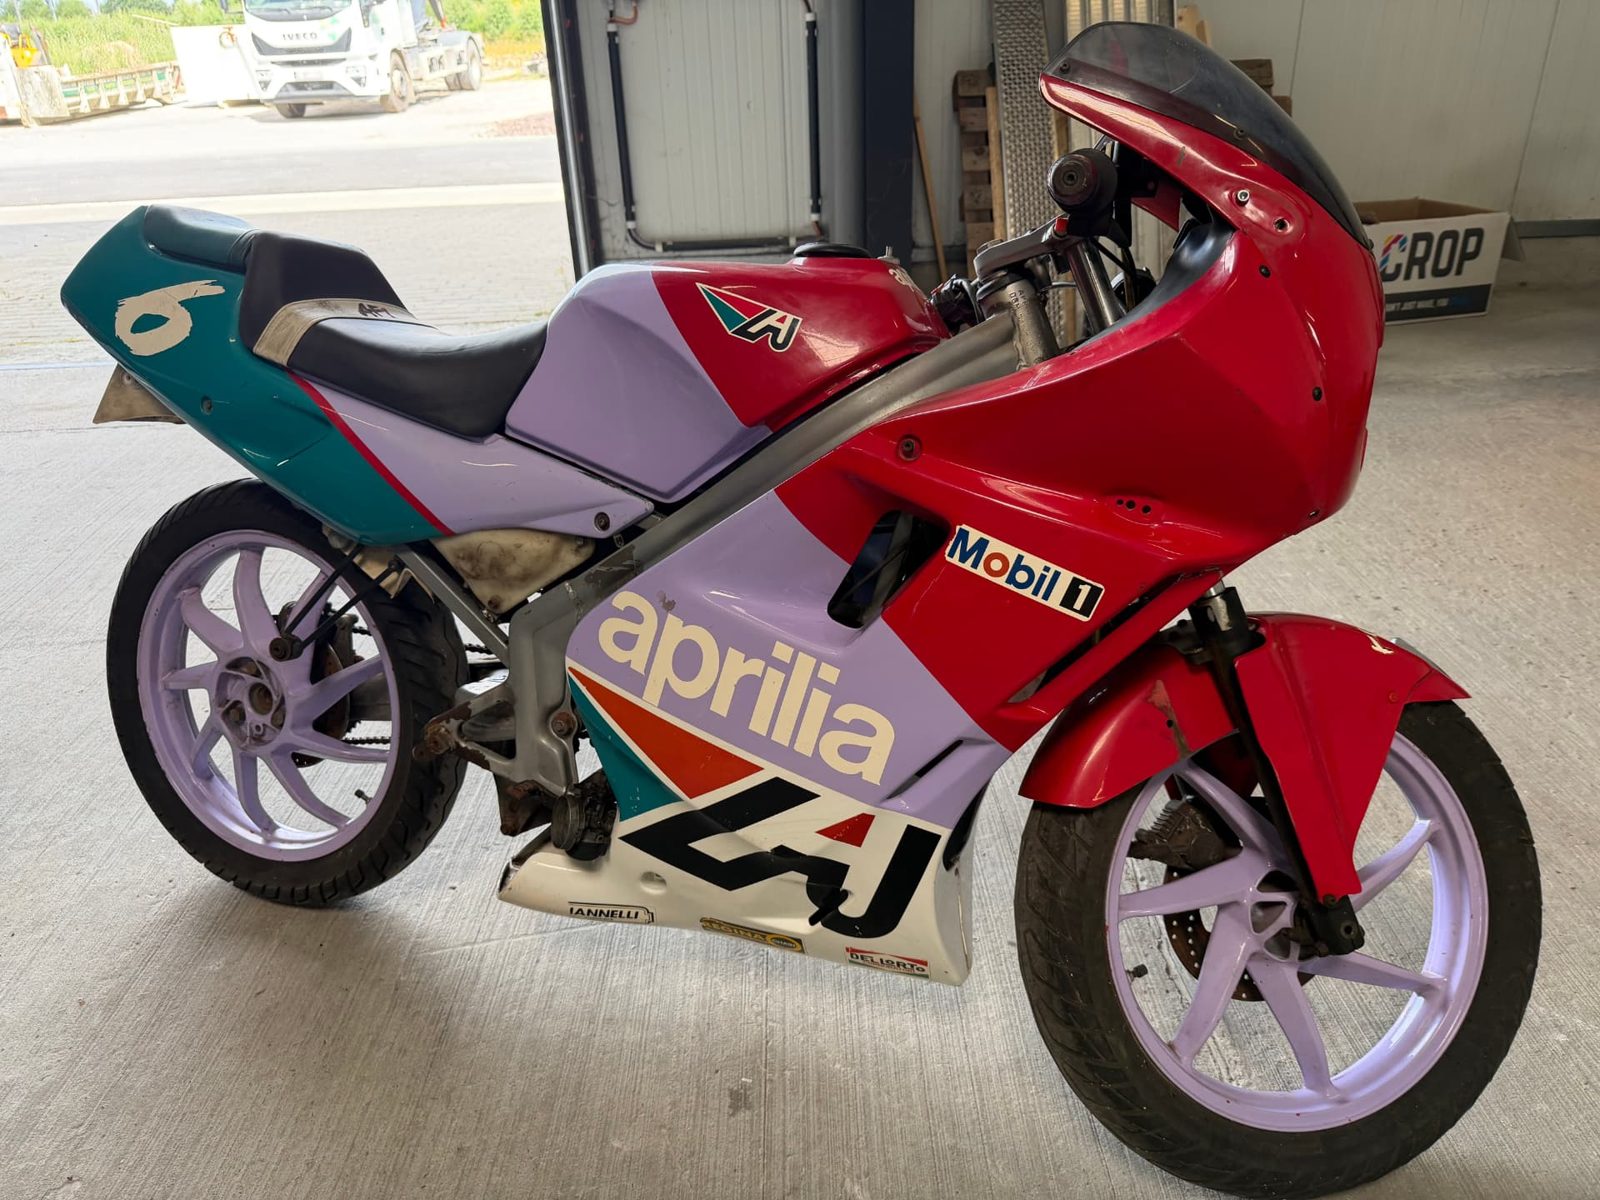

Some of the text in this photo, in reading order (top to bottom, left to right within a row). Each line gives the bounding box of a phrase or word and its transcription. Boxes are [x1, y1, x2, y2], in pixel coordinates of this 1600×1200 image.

[282, 31, 319, 41] IVECO
[1379, 227, 1485, 283] CROP
[114, 279, 226, 357] 6
[947, 527, 1093, 611] Mobil 1
[598, 590, 895, 786] aprilia
[569, 906, 640, 920] IANNELLI
